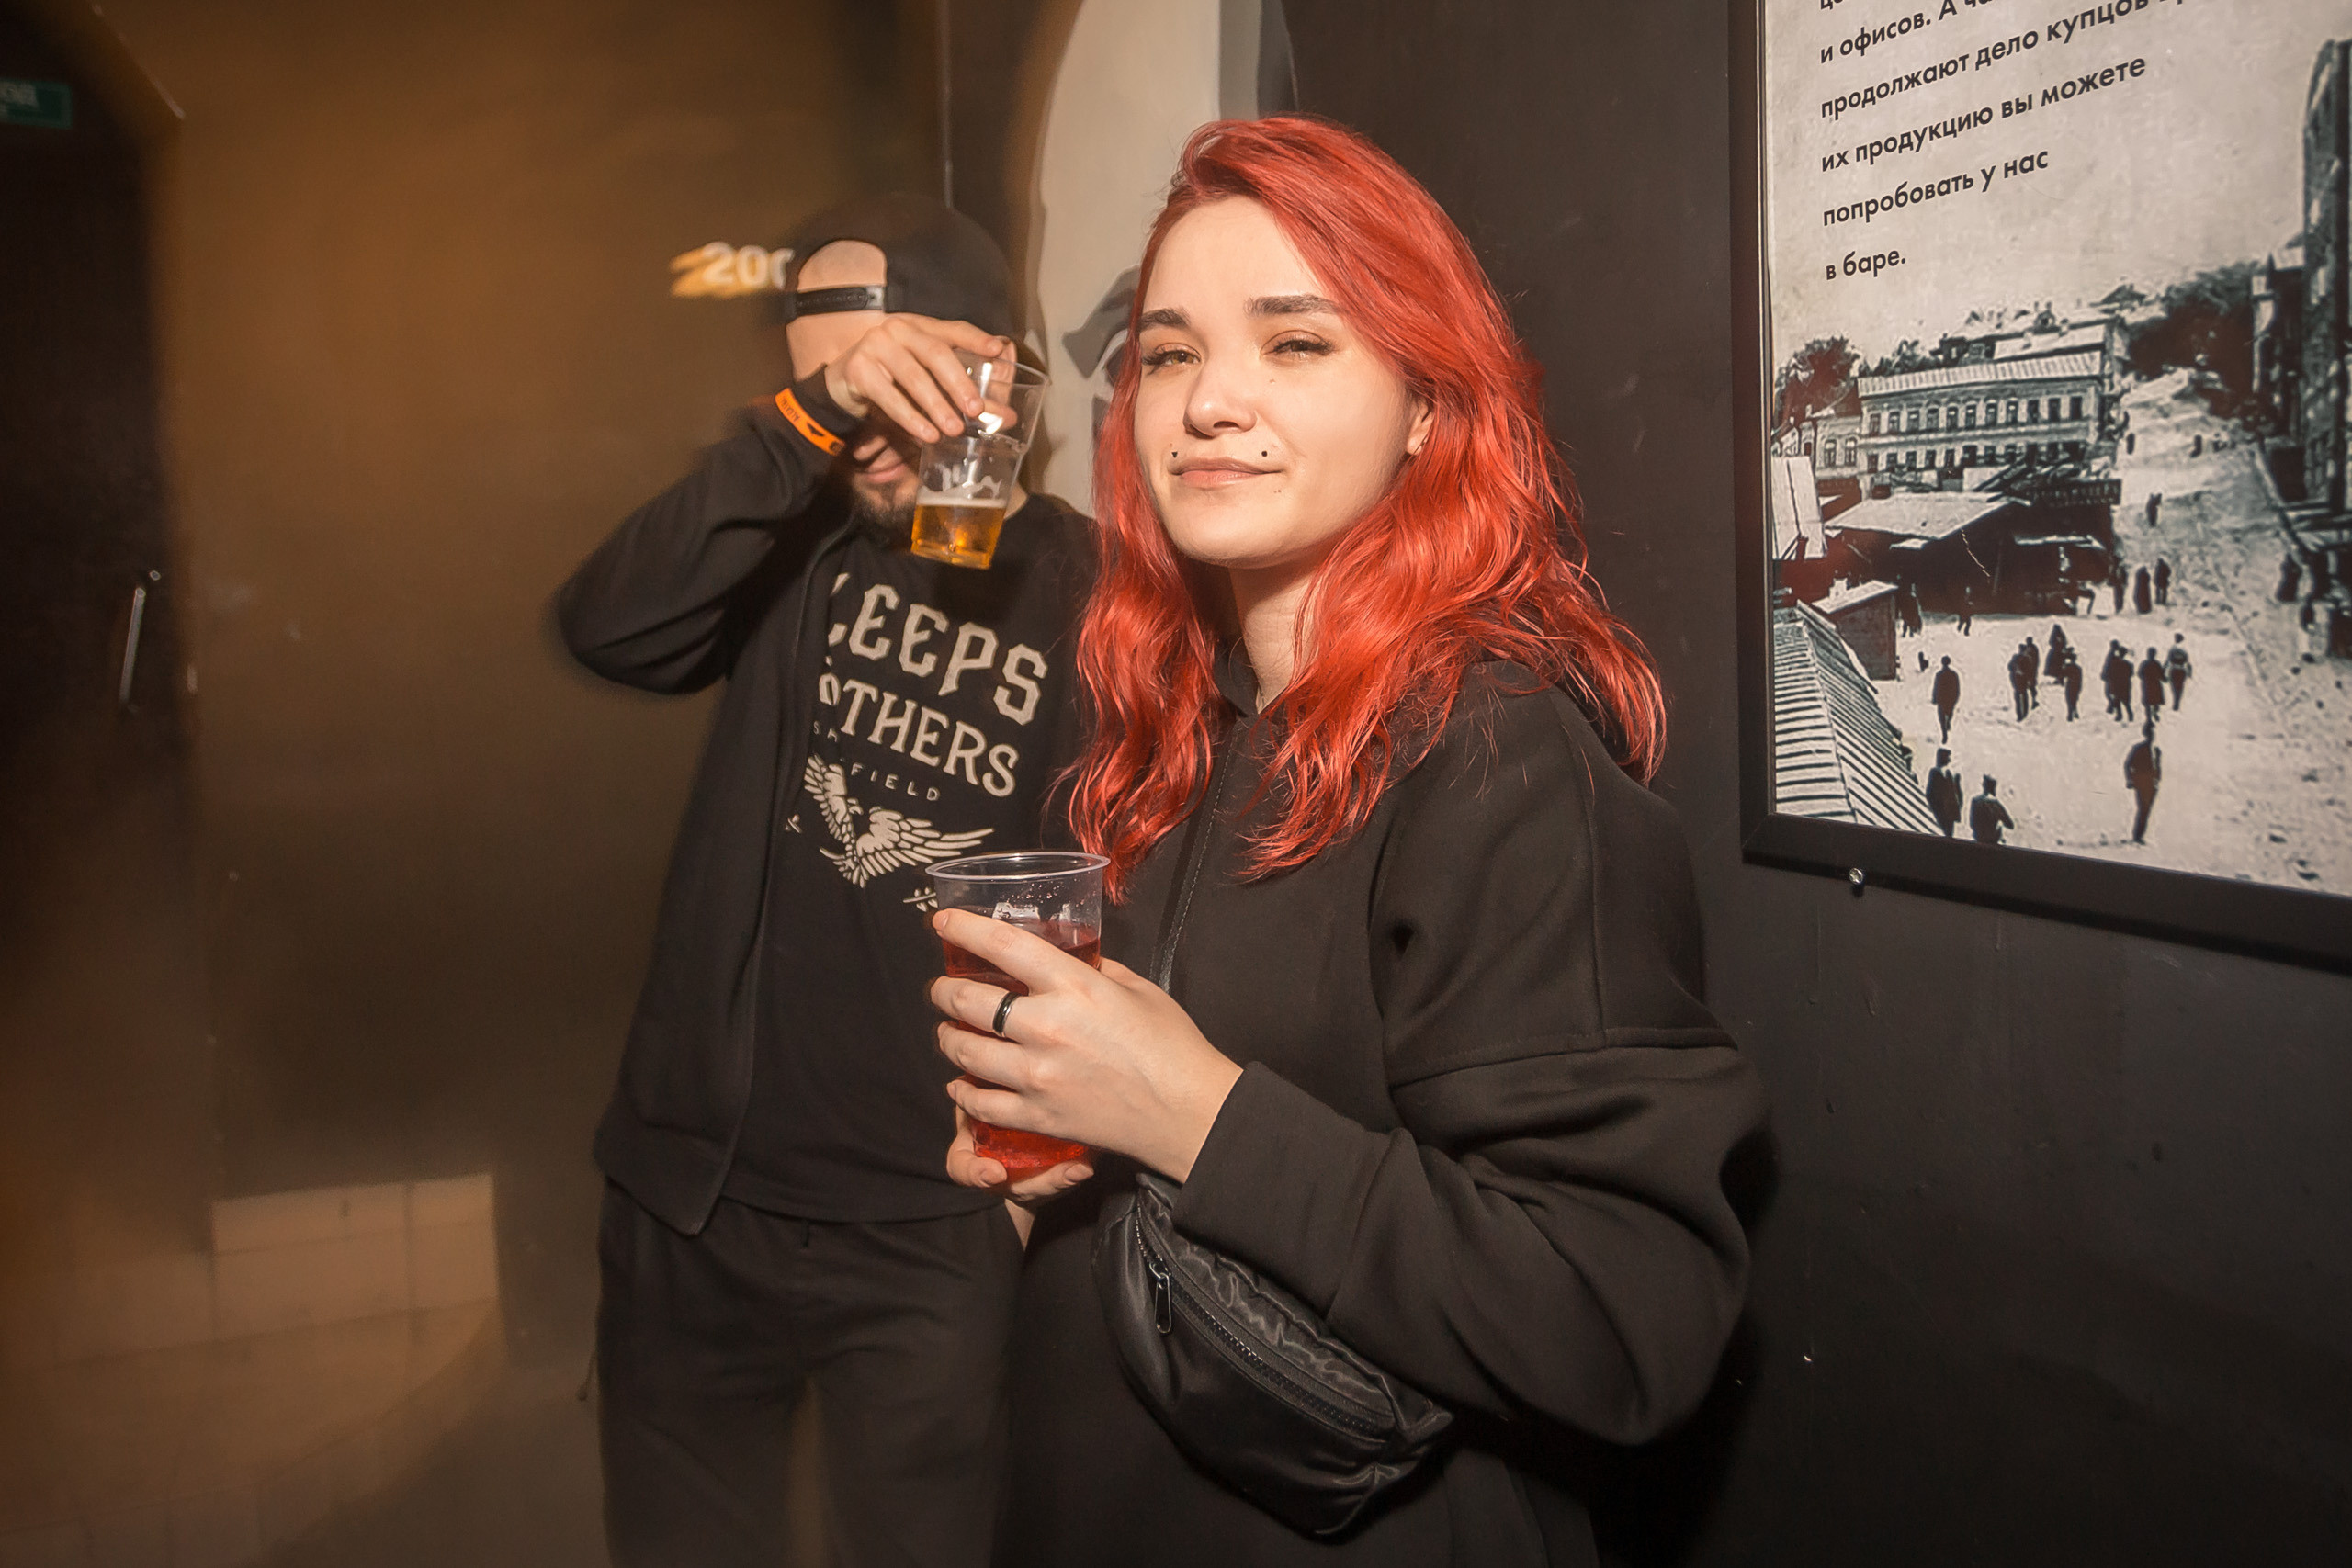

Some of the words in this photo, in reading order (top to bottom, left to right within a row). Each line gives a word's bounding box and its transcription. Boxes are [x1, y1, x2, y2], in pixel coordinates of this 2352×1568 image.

[1820, 46, 1834, 64] и
[1839, 12, 1931, 57] офисов.
[1938, 0, 1958, 21] А
[1821, 53, 1970, 121] продолжают
[1975, 30, 2039, 71] дело
[2047, 0, 2150, 44] купцов
[1822, 150, 1849, 173] их
[1855, 107, 1994, 165] продукцию
[2001, 94, 2033, 118] вы
[2040, 57, 2146, 107] можете
[1823, 174, 1974, 227] попробовать
[1980, 165, 1996, 193] у
[2003, 151, 2049, 179] нас
[1826, 265, 1837, 281] в
[1843, 250, 1906, 277] баре.
